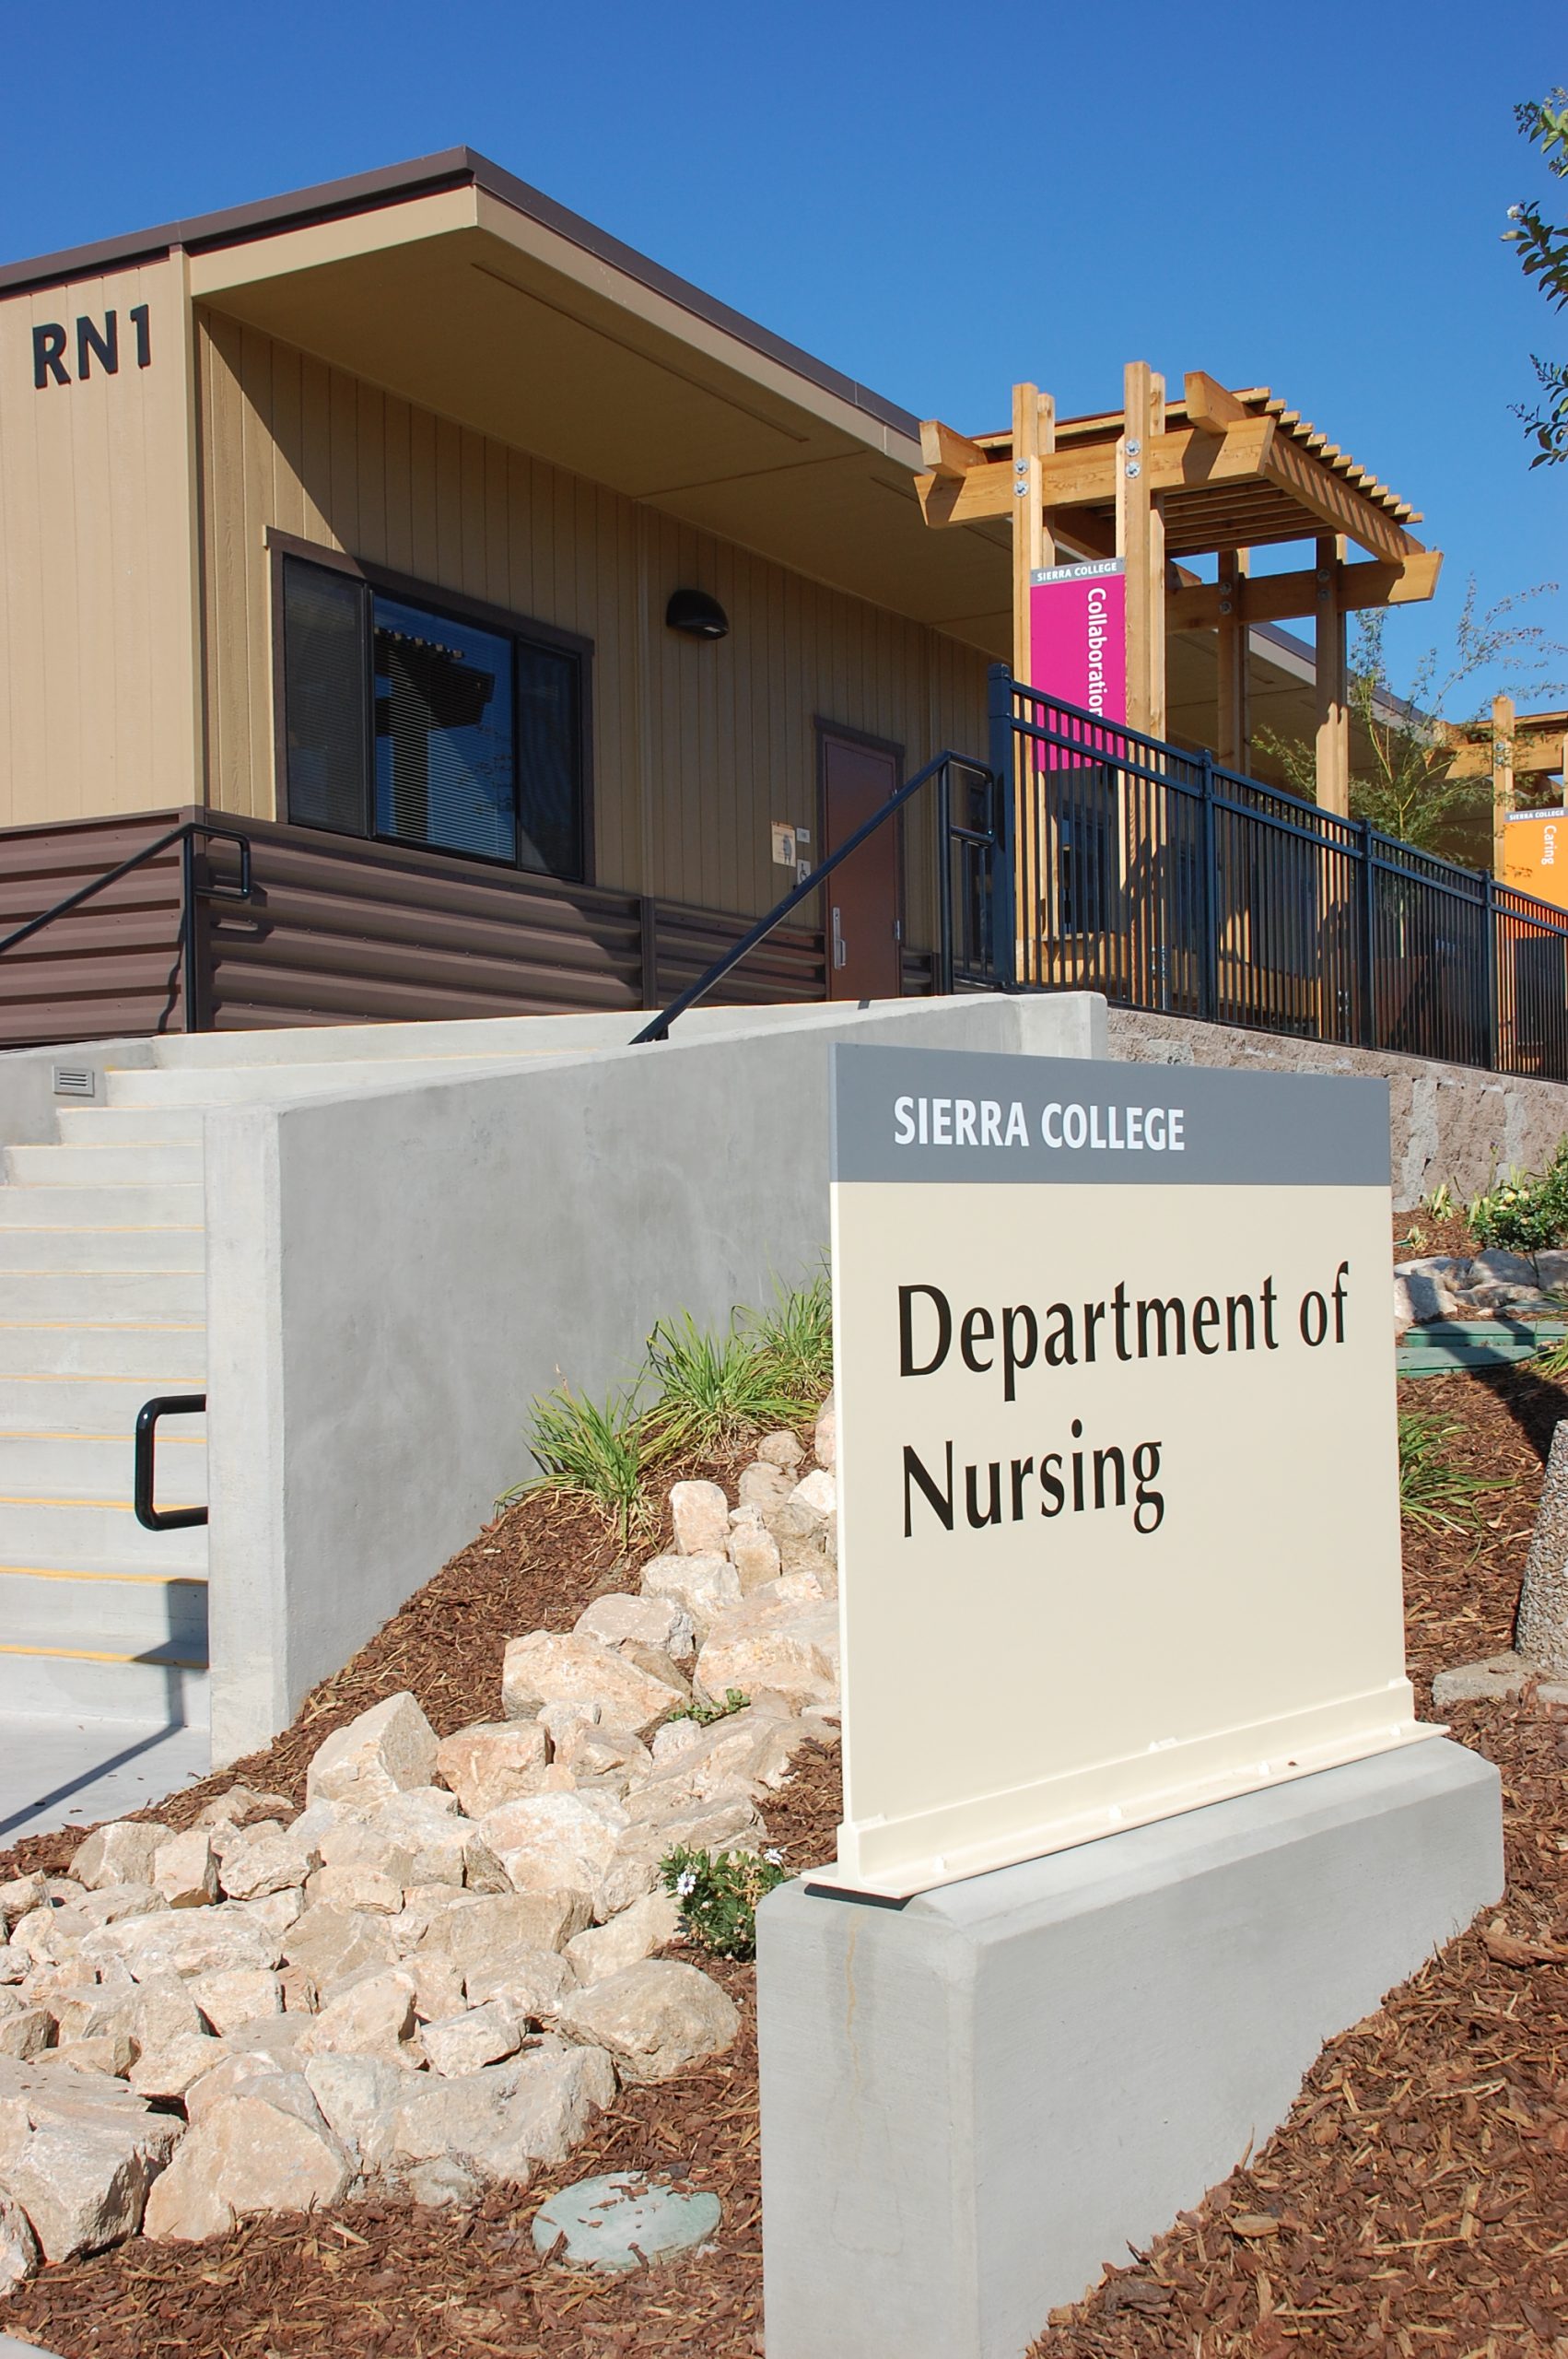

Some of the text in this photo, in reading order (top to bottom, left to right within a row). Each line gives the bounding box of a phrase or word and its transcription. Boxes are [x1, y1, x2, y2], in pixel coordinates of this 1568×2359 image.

[32, 304, 150, 390] RN1
[1036, 561, 1117, 582] SIERRA COLLEGE
[1509, 809, 1564, 821] SIERRA COLLEGE
[1541, 825, 1557, 865] Caring
[894, 1096, 1186, 1151] SIERRA COLLEGE
[898, 1261, 1349, 1402] Department of
[903, 1418, 1165, 1538] Nursing
